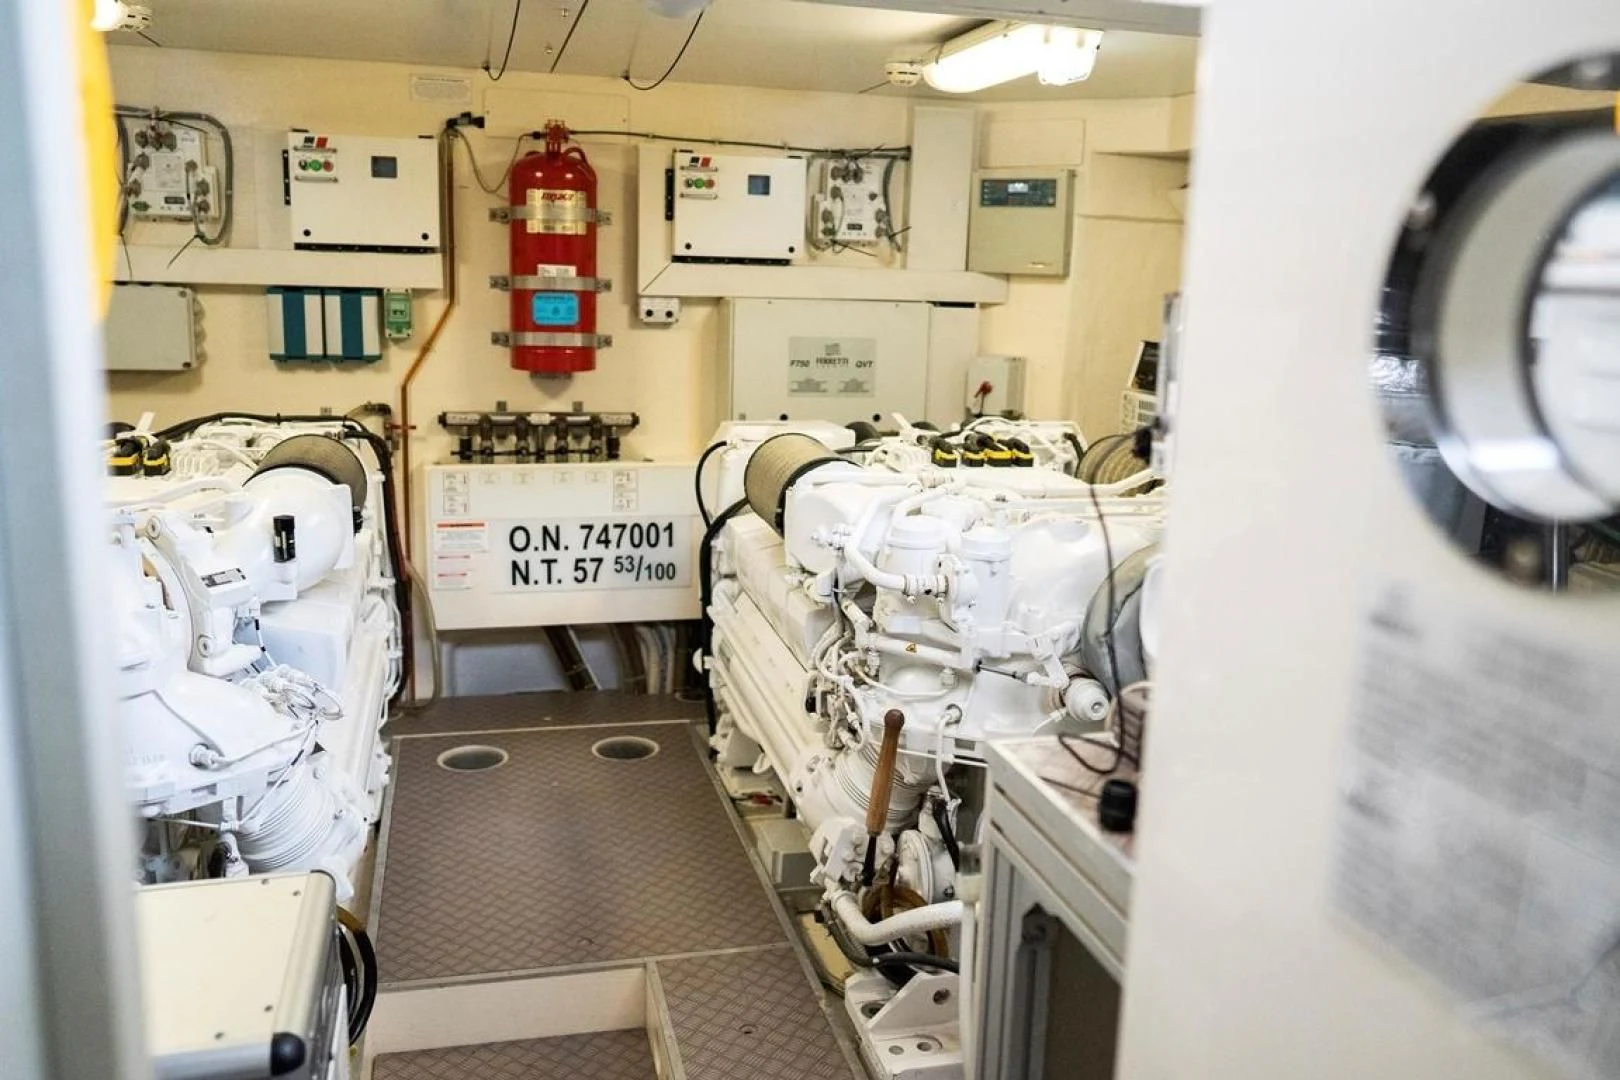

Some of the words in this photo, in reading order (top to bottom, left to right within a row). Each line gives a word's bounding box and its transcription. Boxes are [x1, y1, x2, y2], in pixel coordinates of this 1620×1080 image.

[509, 525, 569, 553] O.N.
[580, 522, 674, 550] 747001
[511, 558, 563, 586] N.T.
[574, 557, 604, 584] 57
